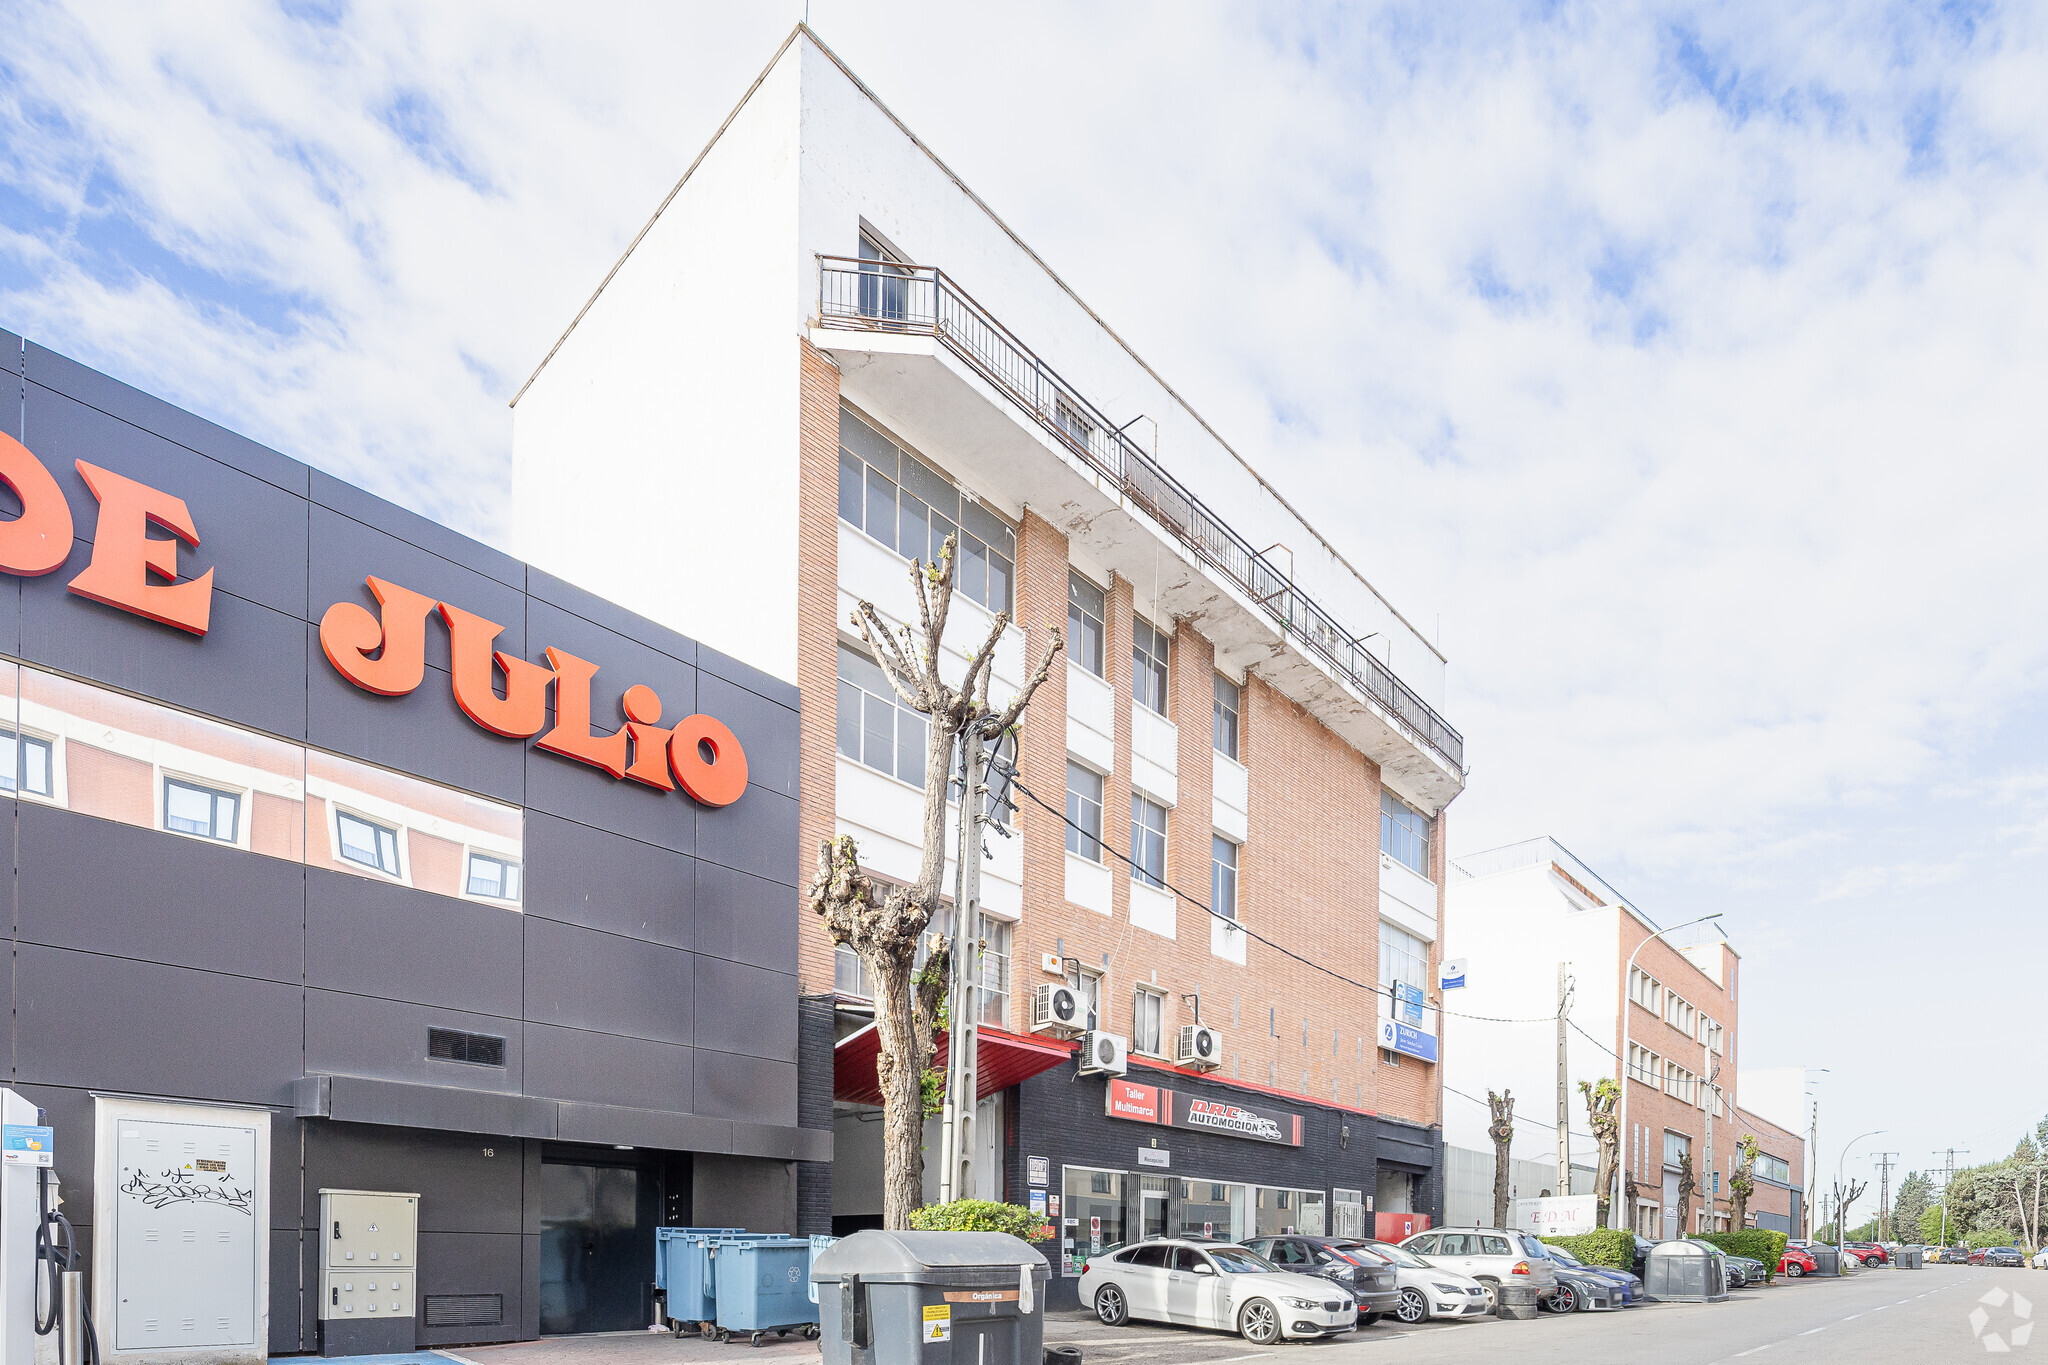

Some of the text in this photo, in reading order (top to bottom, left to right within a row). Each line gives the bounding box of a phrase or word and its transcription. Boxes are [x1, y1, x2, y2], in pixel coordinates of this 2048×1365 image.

[1125, 1087, 1145, 1101] Taller
[1115, 1100, 1154, 1117] Multimarca
[1190, 1112, 1260, 1132] AUTOMOCION
[482, 1147, 494, 1158] 16
[972, 1293, 1003, 1302] Orgánica
